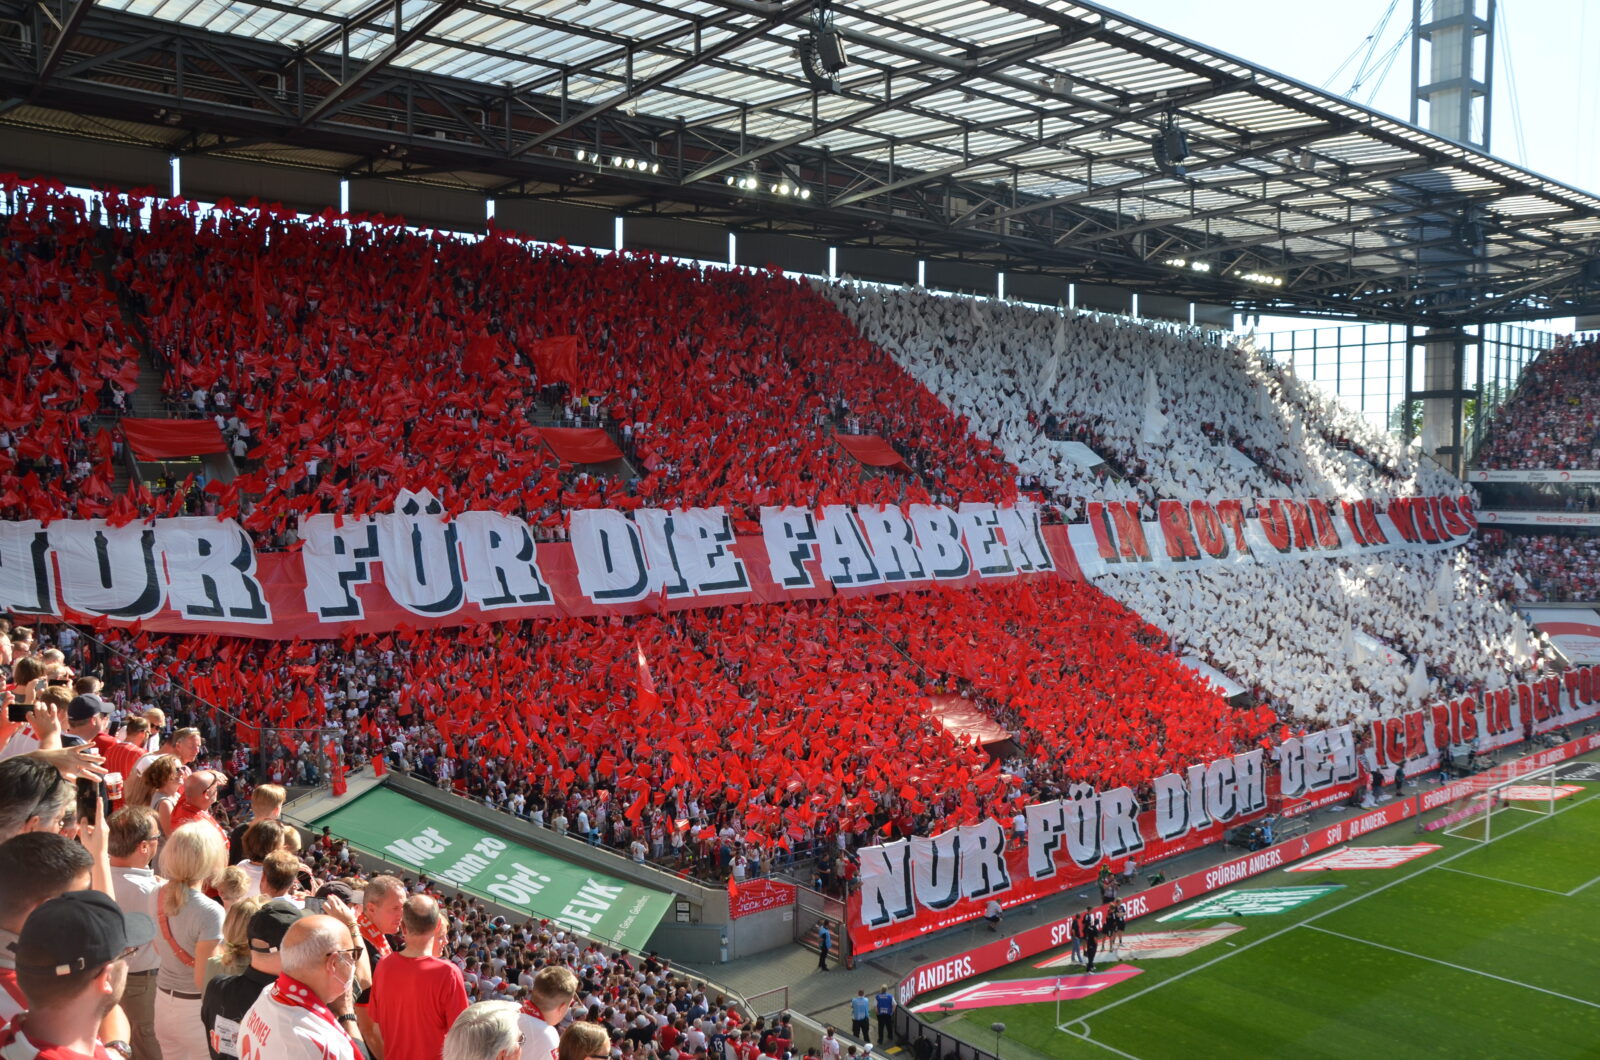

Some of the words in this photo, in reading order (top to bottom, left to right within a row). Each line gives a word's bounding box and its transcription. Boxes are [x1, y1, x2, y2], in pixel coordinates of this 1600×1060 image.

[298, 487, 555, 623] FÜR
[570, 505, 752, 604] DIE
[760, 501, 1056, 589] FARBEN
[1087, 500, 1153, 564] IN
[1157, 498, 1250, 560] ROT
[1256, 498, 1341, 554] UND
[1341, 499, 1390, 548] IN
[1387, 496, 1479, 544] WEISS
[857, 817, 1012, 931] NUR
[1025, 782, 1145, 881] FÜR
[1153, 748, 1267, 842] DICH
[1281, 725, 1360, 798] GEH
[1372, 710, 1428, 769] ICH
[1431, 697, 1479, 749] BIS
[1485, 686, 1514, 737] IN
[1518, 675, 1563, 724] DEN
[383, 826, 452, 867] Mer
[486, 862, 551, 904] Dir!
[1206, 859, 1247, 890] SPÜRBAR
[1248, 848, 1283, 876] ANDERS.
[552, 877, 624, 937] DEVK
[918, 955, 976, 992] ANDERS.
[713, 1039, 724, 1053] 13
